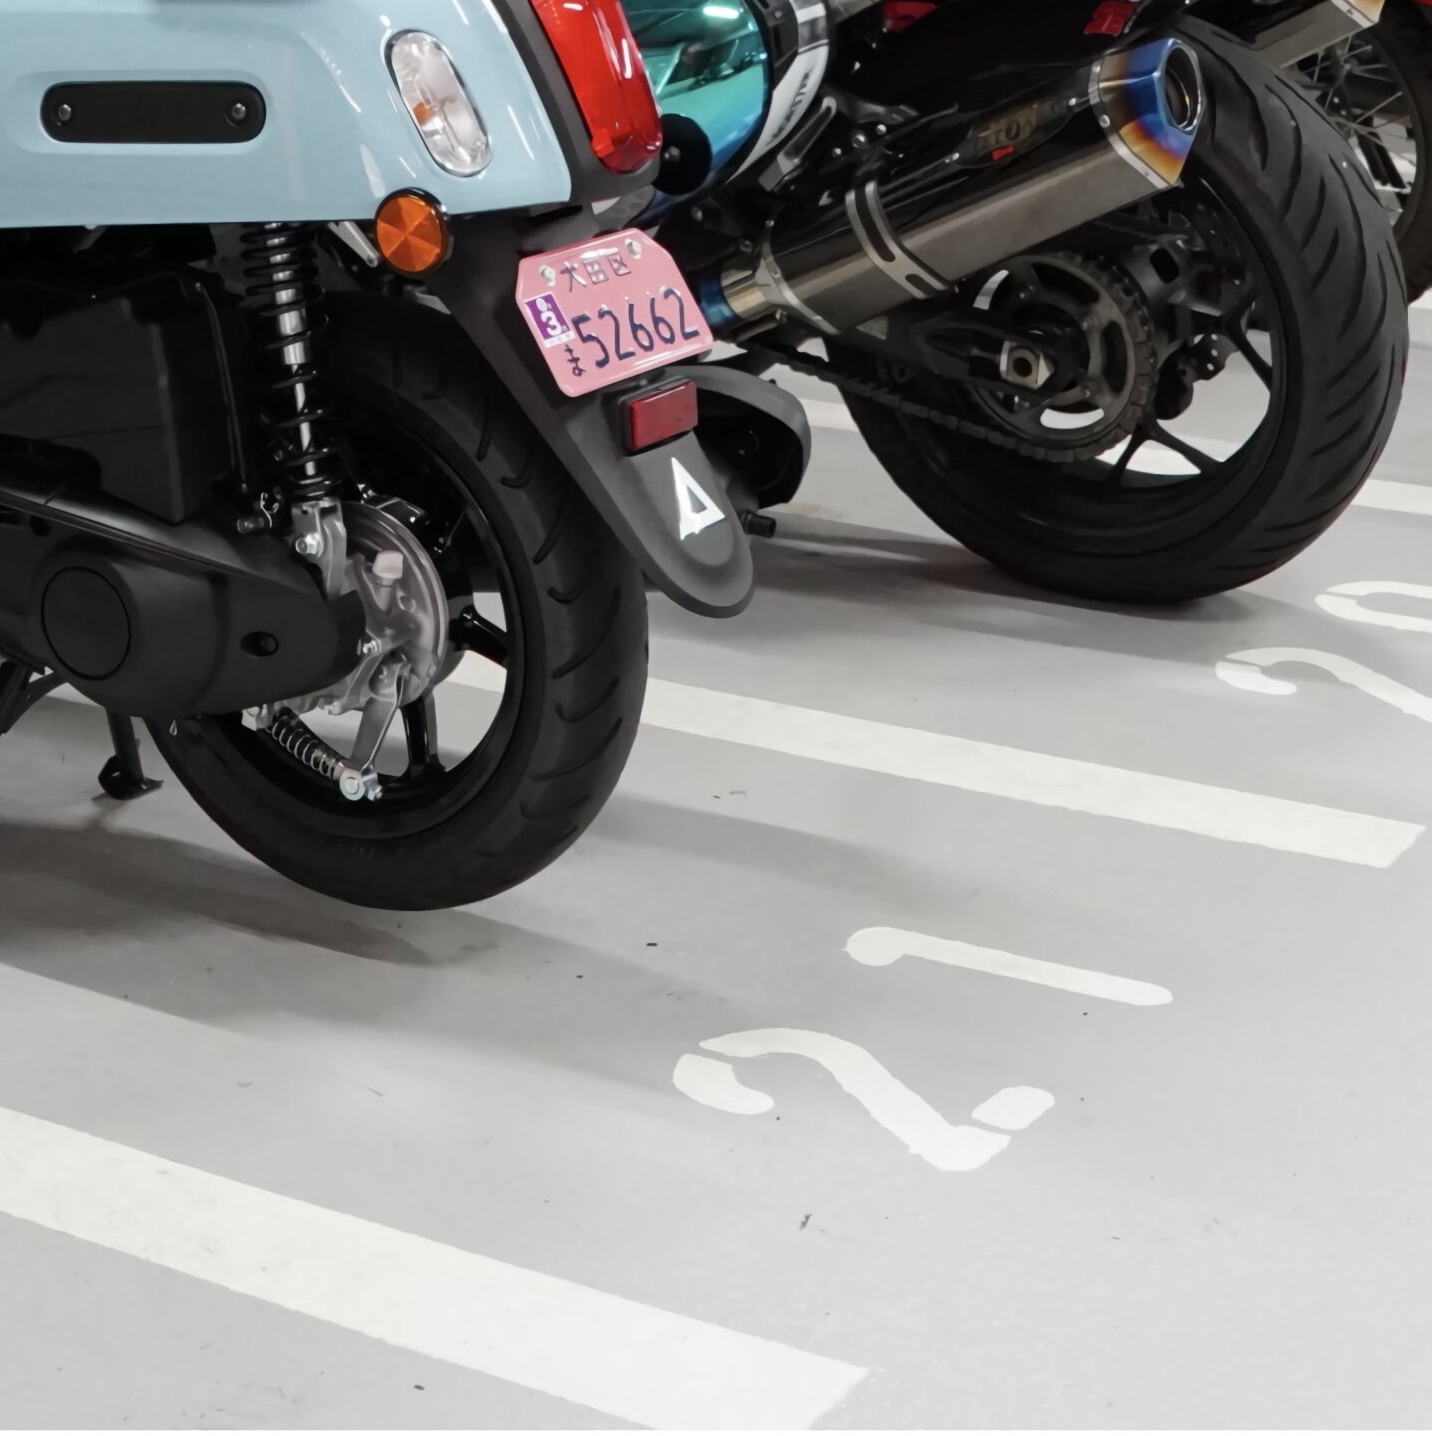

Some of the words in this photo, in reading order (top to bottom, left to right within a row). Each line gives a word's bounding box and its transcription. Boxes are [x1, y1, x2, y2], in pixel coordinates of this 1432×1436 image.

[560, 248, 631, 292] 大田区
[571, 288, 700, 368] 52662
[672, 926, 1173, 1171] 21
